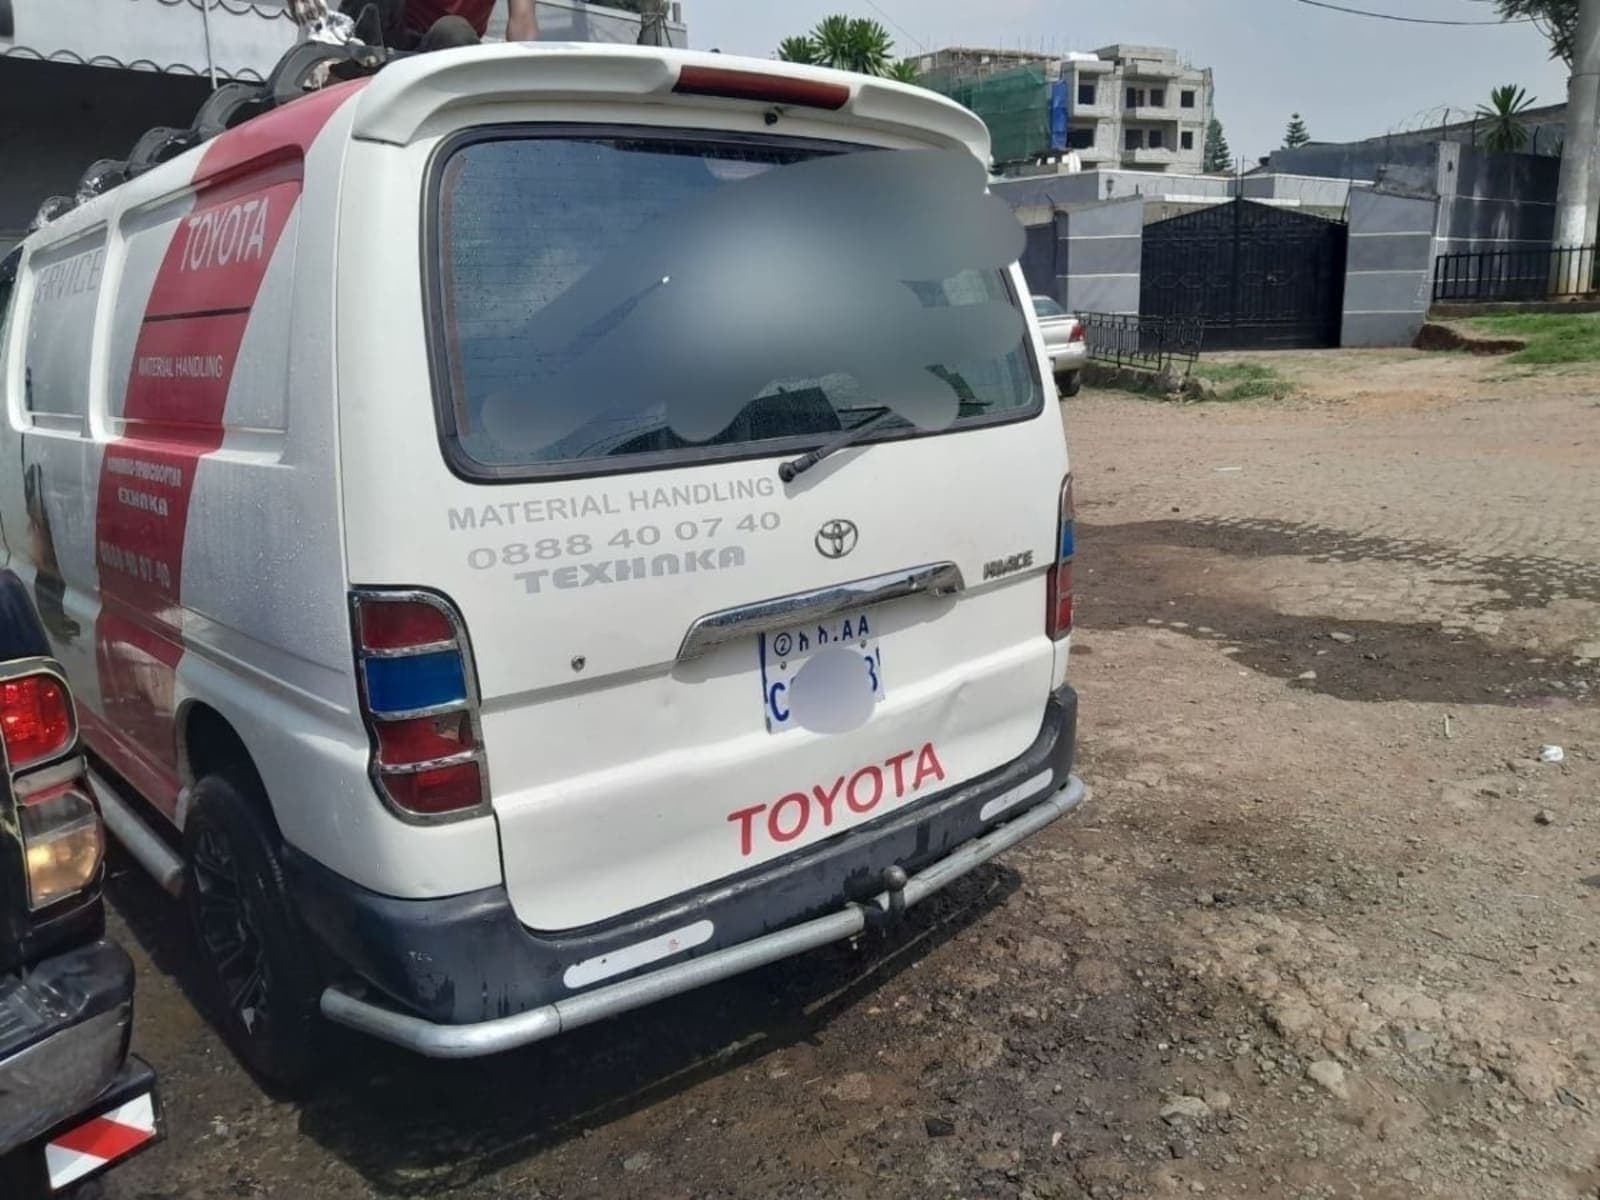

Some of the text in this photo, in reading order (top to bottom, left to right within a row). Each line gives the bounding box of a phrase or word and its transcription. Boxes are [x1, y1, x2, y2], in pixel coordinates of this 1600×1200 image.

[181, 197, 269, 271] TOYOTA
[176, 354, 223, 378] HANDLING
[447, 477, 774, 531] MATERIAL HANDLING
[467, 511, 781, 570] 0888 40 07 40
[727, 742, 945, 856] TOYOTA
